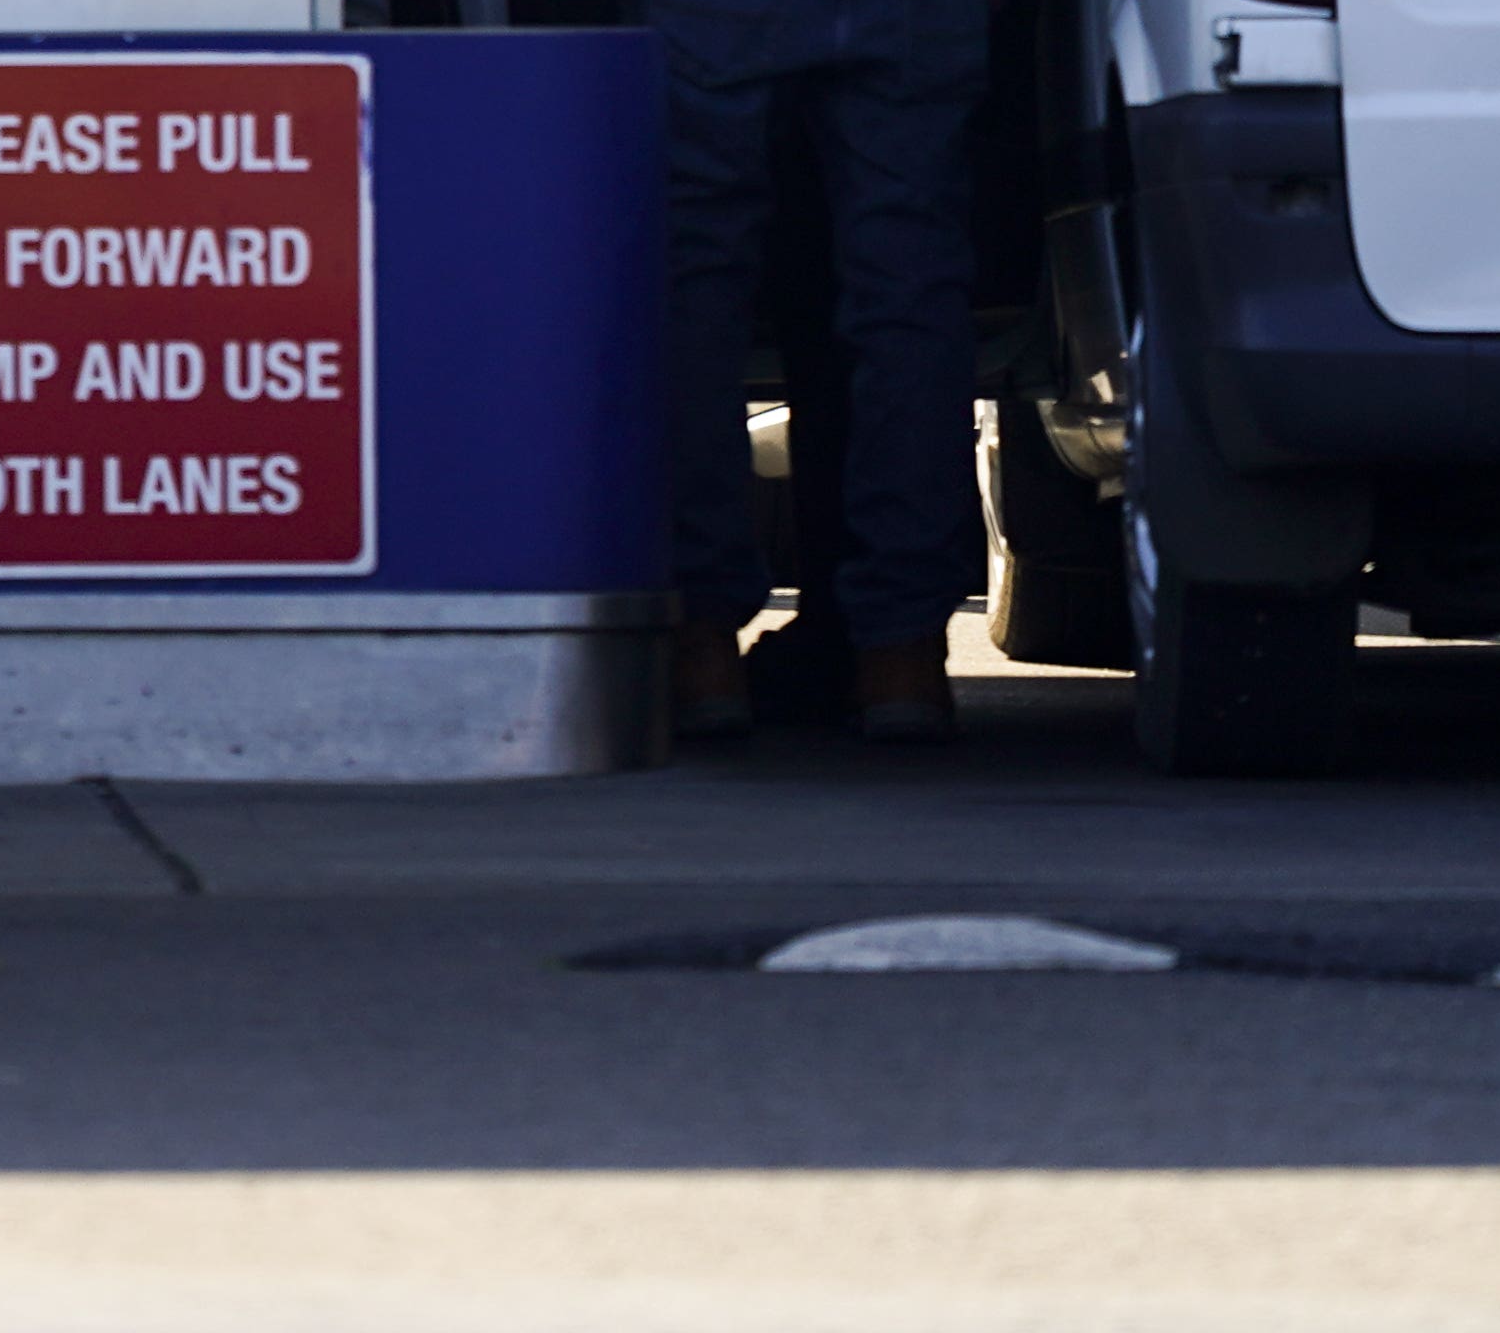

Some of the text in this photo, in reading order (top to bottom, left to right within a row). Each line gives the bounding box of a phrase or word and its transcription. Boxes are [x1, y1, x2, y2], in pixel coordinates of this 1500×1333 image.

[157, 113, 310, 173] PULL
[6, 227, 311, 288] FORWARD
[74, 341, 205, 402] AND
[223, 340, 343, 401] USE
[102, 455, 302, 515] LANES
